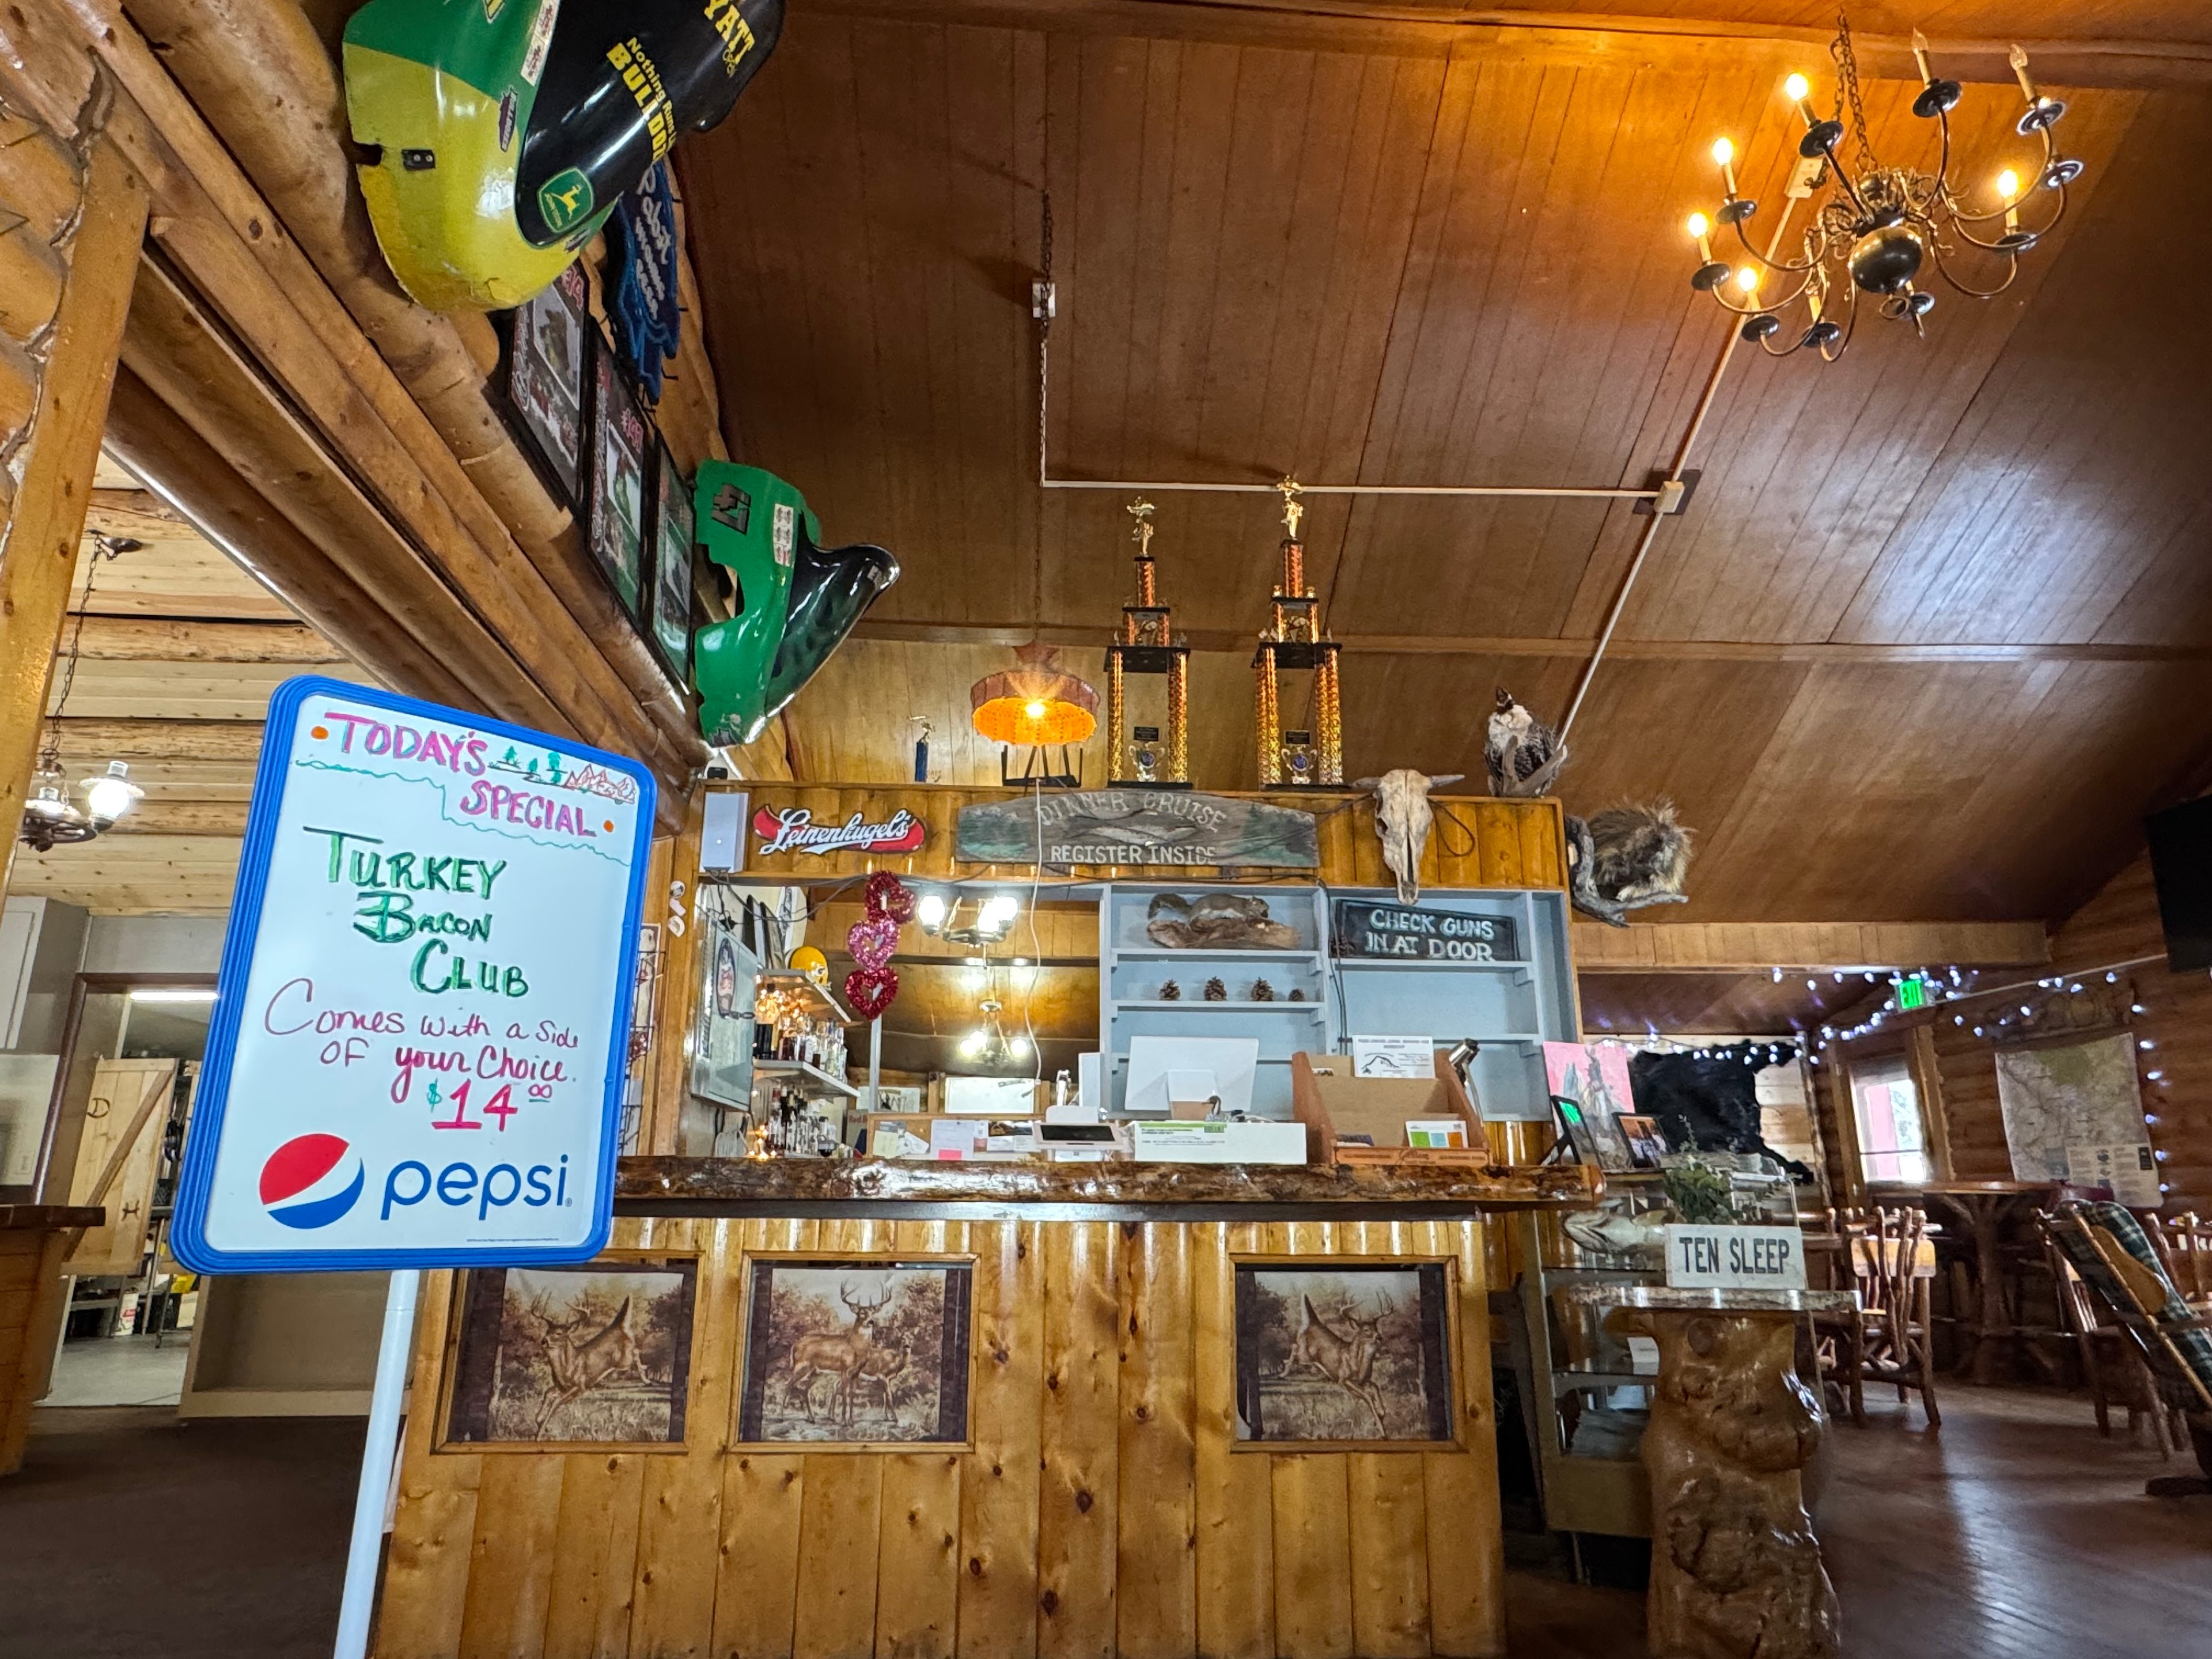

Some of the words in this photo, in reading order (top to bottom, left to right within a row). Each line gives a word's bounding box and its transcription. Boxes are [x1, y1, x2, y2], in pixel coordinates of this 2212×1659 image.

[626, 36, 666, 102] Nothing
[324, 711, 488, 777] TODAY'S
[460, 779, 597, 838] SPECIAL
[1143, 791, 1228, 833] CRUISE
[302, 825, 507, 900] TURKEY
[1051, 845, 1142, 863] REGISTER
[1146, 844, 1217, 865] INSIDE
[353, 891, 493, 943] BACON
[1364, 931, 1389, 953] IN
[1391, 934, 1419, 955] AT
[1427, 938, 1497, 961] DOOR
[1369, 908, 1437, 934] CHECK
[1440, 917, 1495, 941] GUNS
[410, 938, 529, 998] CLUB
[264, 978, 406, 1036] Comes
[506, 1022, 531, 1039] a
[391, 1047, 471, 1104] your
[380, 1154, 569, 1221] pepsi
[1679, 1236, 1720, 1274] TEN
[1729, 1237, 1790, 1275] SLEEP
